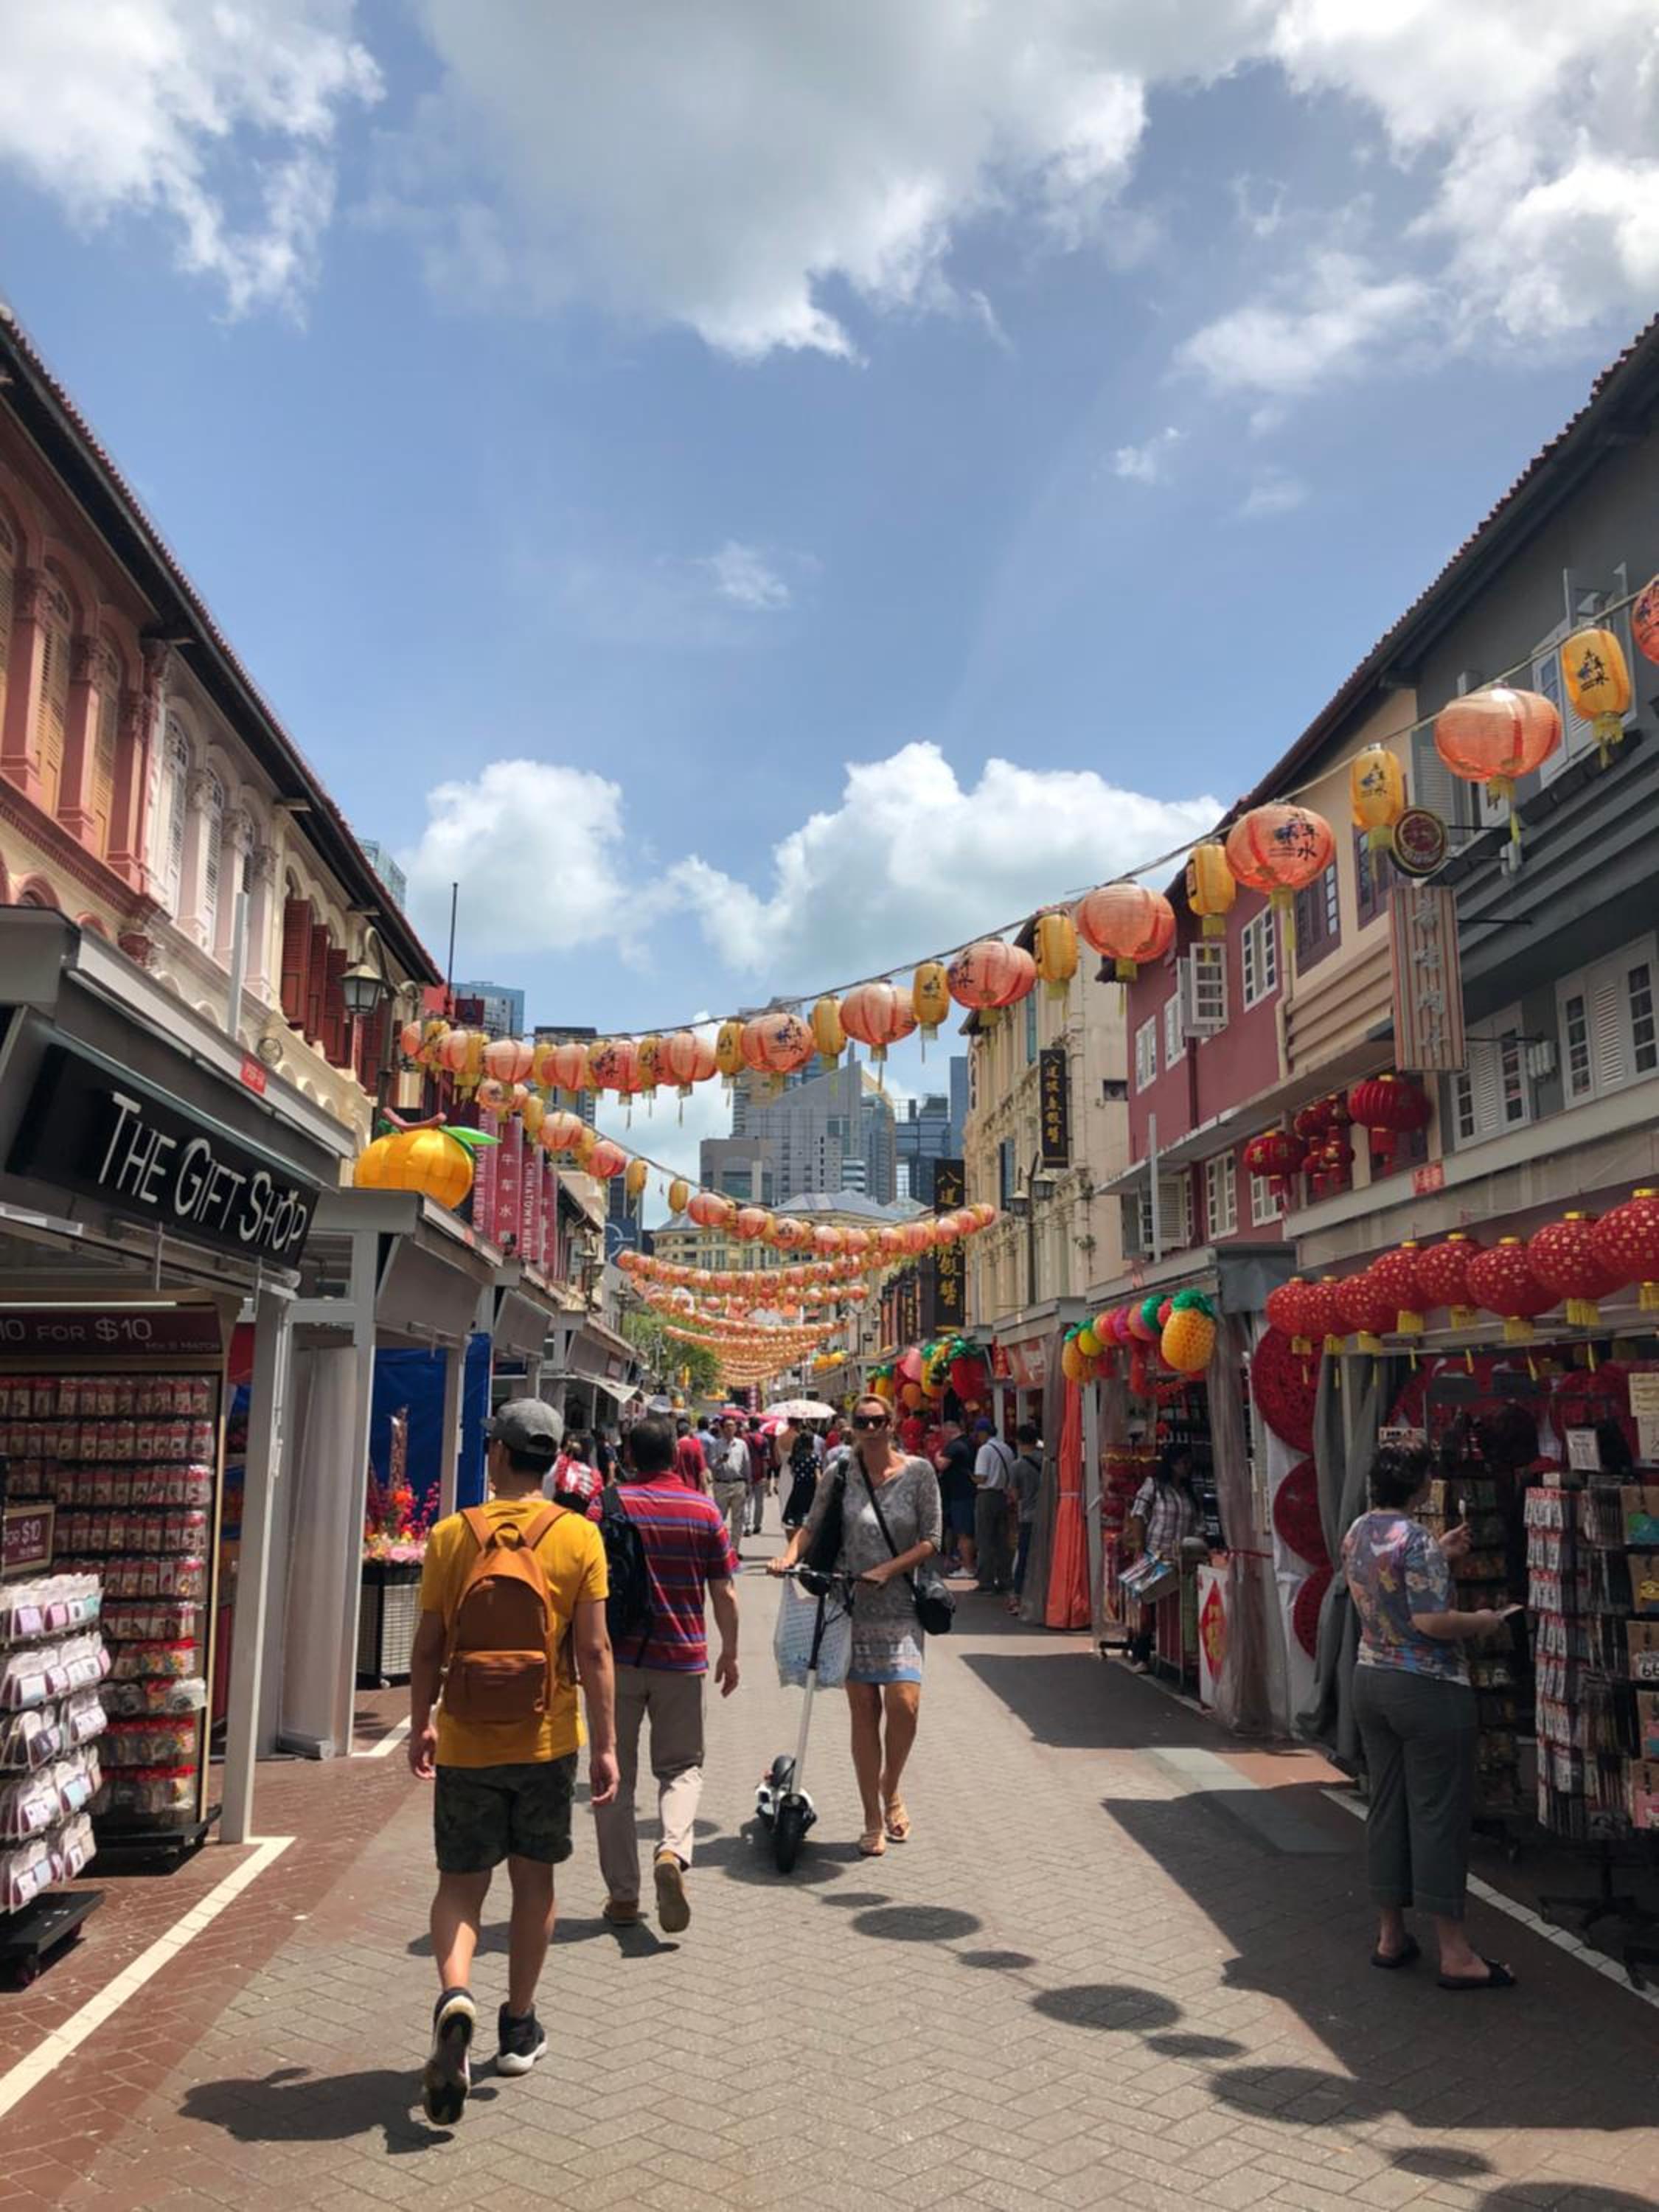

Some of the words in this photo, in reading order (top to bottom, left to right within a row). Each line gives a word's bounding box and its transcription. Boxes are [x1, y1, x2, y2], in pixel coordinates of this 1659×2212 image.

[97, 1091, 177, 1204] THE
[175, 1138, 246, 1231] GIFT
[239, 1171, 307, 1253] SHOP
[523, 1161, 536, 1225] CHINATOWN
[38, 1326, 86, 1340] FOR
[94, 1318, 153, 1342] $10
